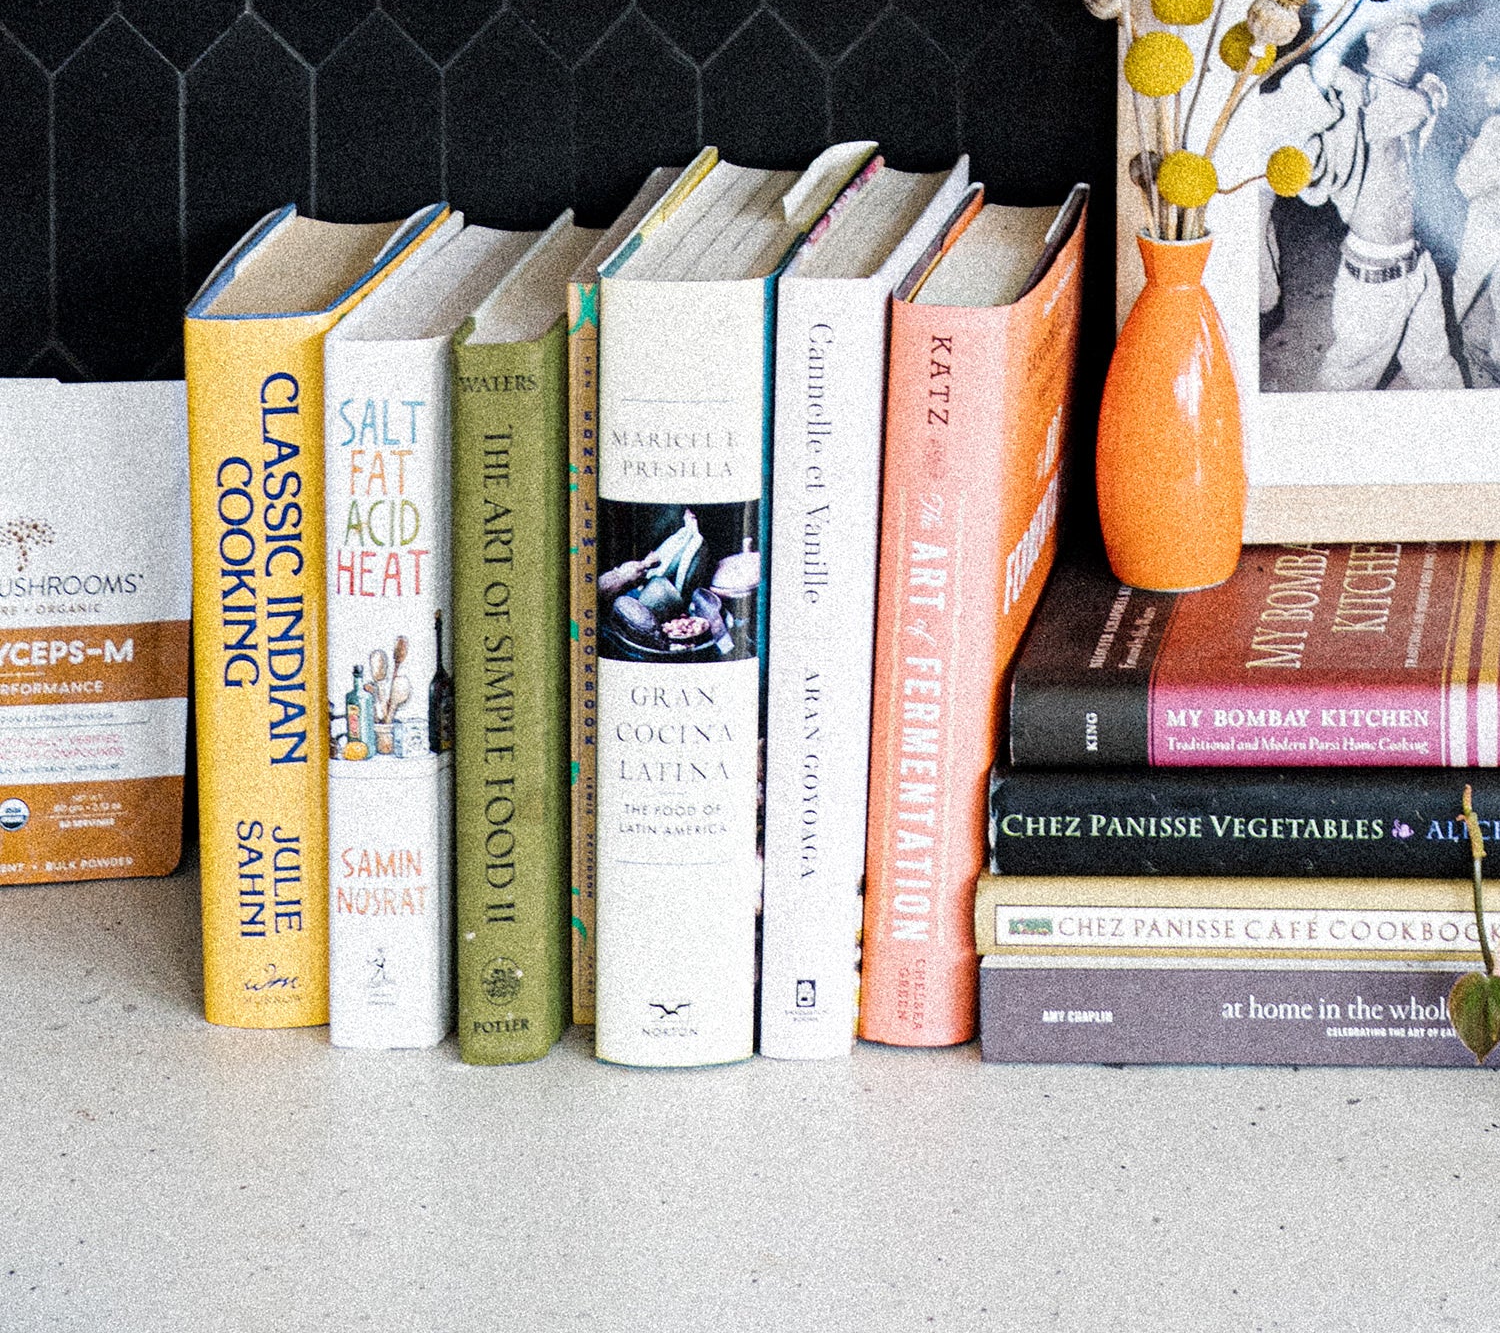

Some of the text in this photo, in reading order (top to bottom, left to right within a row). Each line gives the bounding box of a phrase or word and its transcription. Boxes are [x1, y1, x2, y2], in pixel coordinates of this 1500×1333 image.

[458, 374, 537, 393] WATERS
[927, 334, 953, 426] KATZ
[338, 398, 426, 447] SALT
[583, 410, 594, 476] EDNA
[349, 449, 414, 496] FAT
[483, 424, 514, 486] THE
[622, 458, 734, 479] PRESILLA
[802, 322, 834, 605] Cannelle et Vanille
[343, 499, 421, 547] ACID
[483, 498, 514, 571] ART
[582, 501, 595, 584] LEWIS
[216, 456, 261, 689] COOKING
[260, 371, 309, 766] CLASSIC INDIAN
[335, 549, 430, 598] HEAT
[908, 541, 950, 612] ART
[1330, 544, 1402, 634] KITCHE
[483, 581, 512, 623] OF
[1245, 626, 1310, 669] MY
[484, 634, 515, 764] SIMPLE
[583, 609, 596, 746] COOKBOOK
[631, 686, 716, 709] GRAN
[615, 721, 735, 745] COCINA
[1085, 712, 1099, 752] KING
[1165, 708, 1429, 729] MY BOMBAY KITCHEN
[1167, 736, 1429, 755] Traditional and Modern Parsi Home Cooking
[618, 759, 732, 783] LATINA
[624, 803, 648, 817] THE
[653, 804, 697, 818] FOOD
[892, 655, 942, 943] FERMENTATION
[484, 777, 516, 890] FOOD
[619, 823, 728, 836] LATIN AMERICA
[1001, 814, 1081, 838] CHEZ
[1087, 814, 1202, 839] PANISSE
[1209, 814, 1384, 841] VEGETABLES
[235, 819, 267, 938] SAHNI
[271, 825, 303, 934] JULIE
[340, 847, 423, 879] SAMIN
[336, 884, 428, 916] NOSRAT
[1058, 916, 1124, 938] CHEZ
[1133, 918, 1234, 939] PANISSE
[1244, 911, 1319, 941] CAFÉ
[473, 1018, 530, 1034] POTTER
[1042, 1010, 1114, 1023] AMY CHAPLIN
[1221, 1000, 1244, 1020] at
[1247, 994, 1312, 1021] home
[1318, 997, 1341, 1021] in
[1347, 995, 1384, 1021] the
